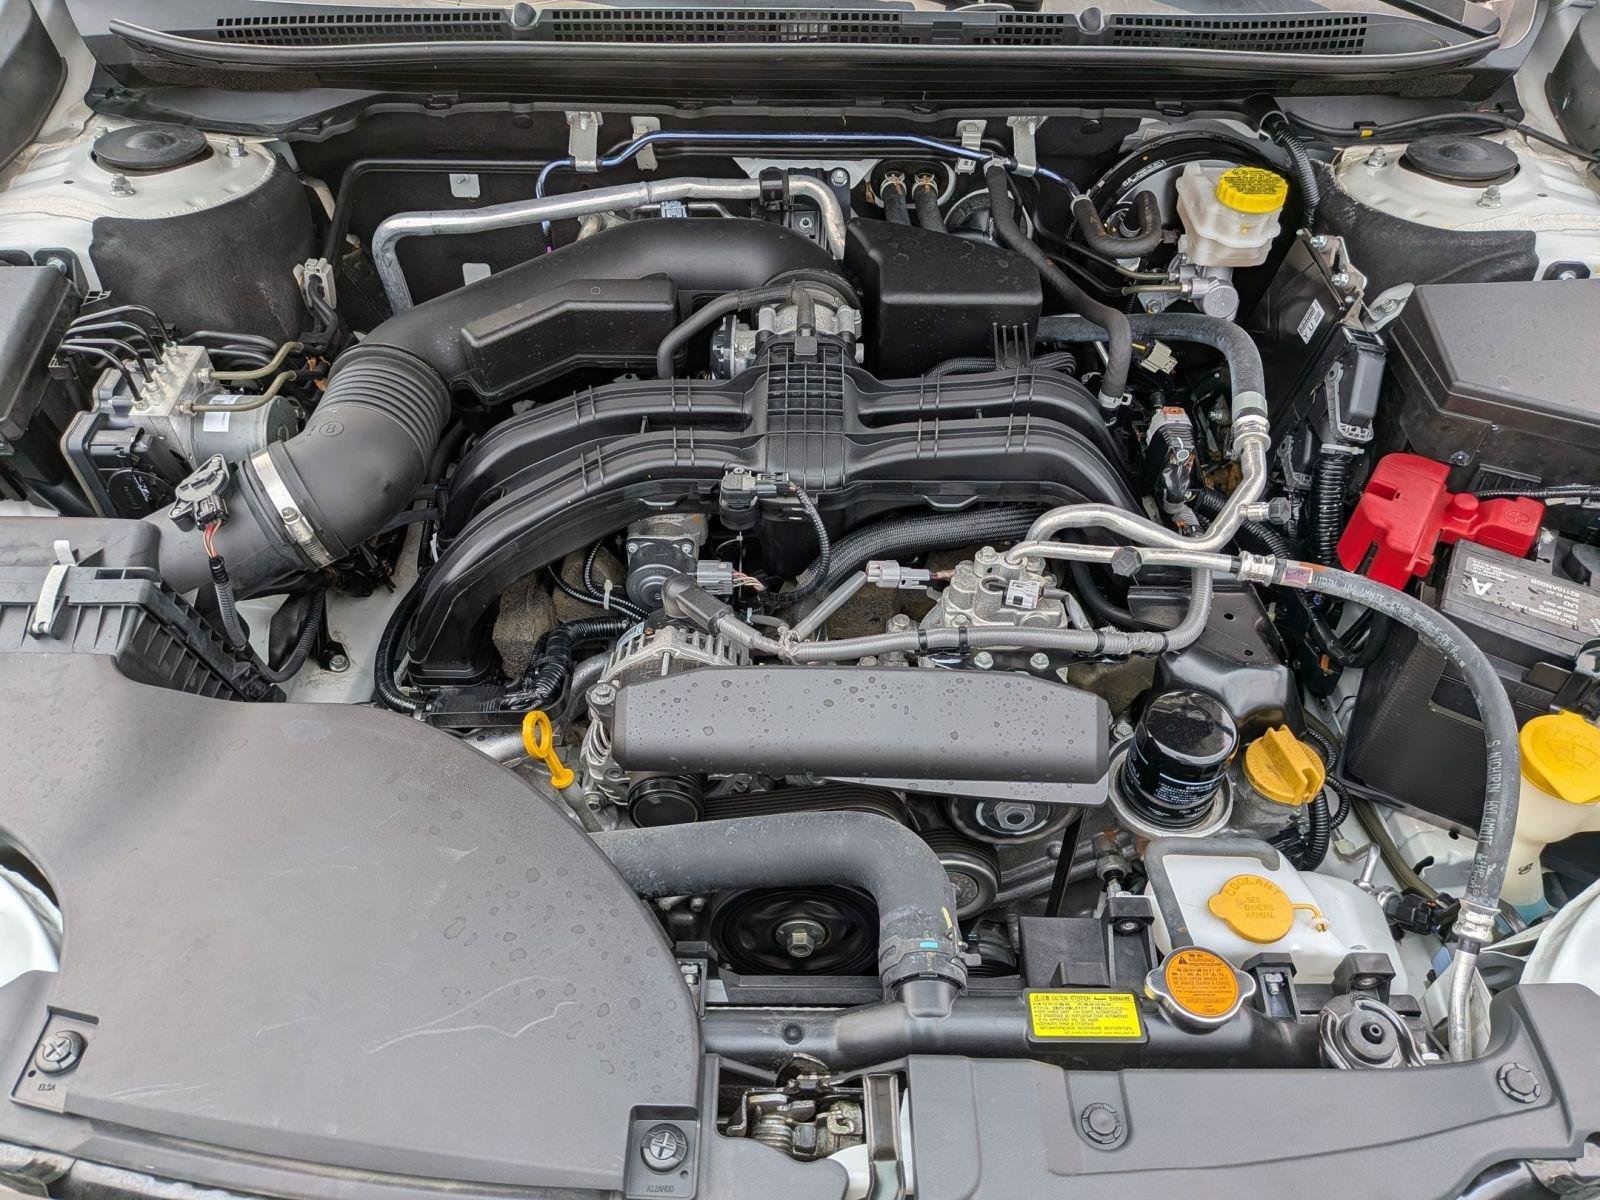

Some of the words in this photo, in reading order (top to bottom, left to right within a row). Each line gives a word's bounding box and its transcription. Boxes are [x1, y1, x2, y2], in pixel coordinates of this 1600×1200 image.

[1471, 576, 1493, 596] A
[1226, 877, 1282, 896] COOLANT
[1245, 911, 1275, 919] MANUAL
